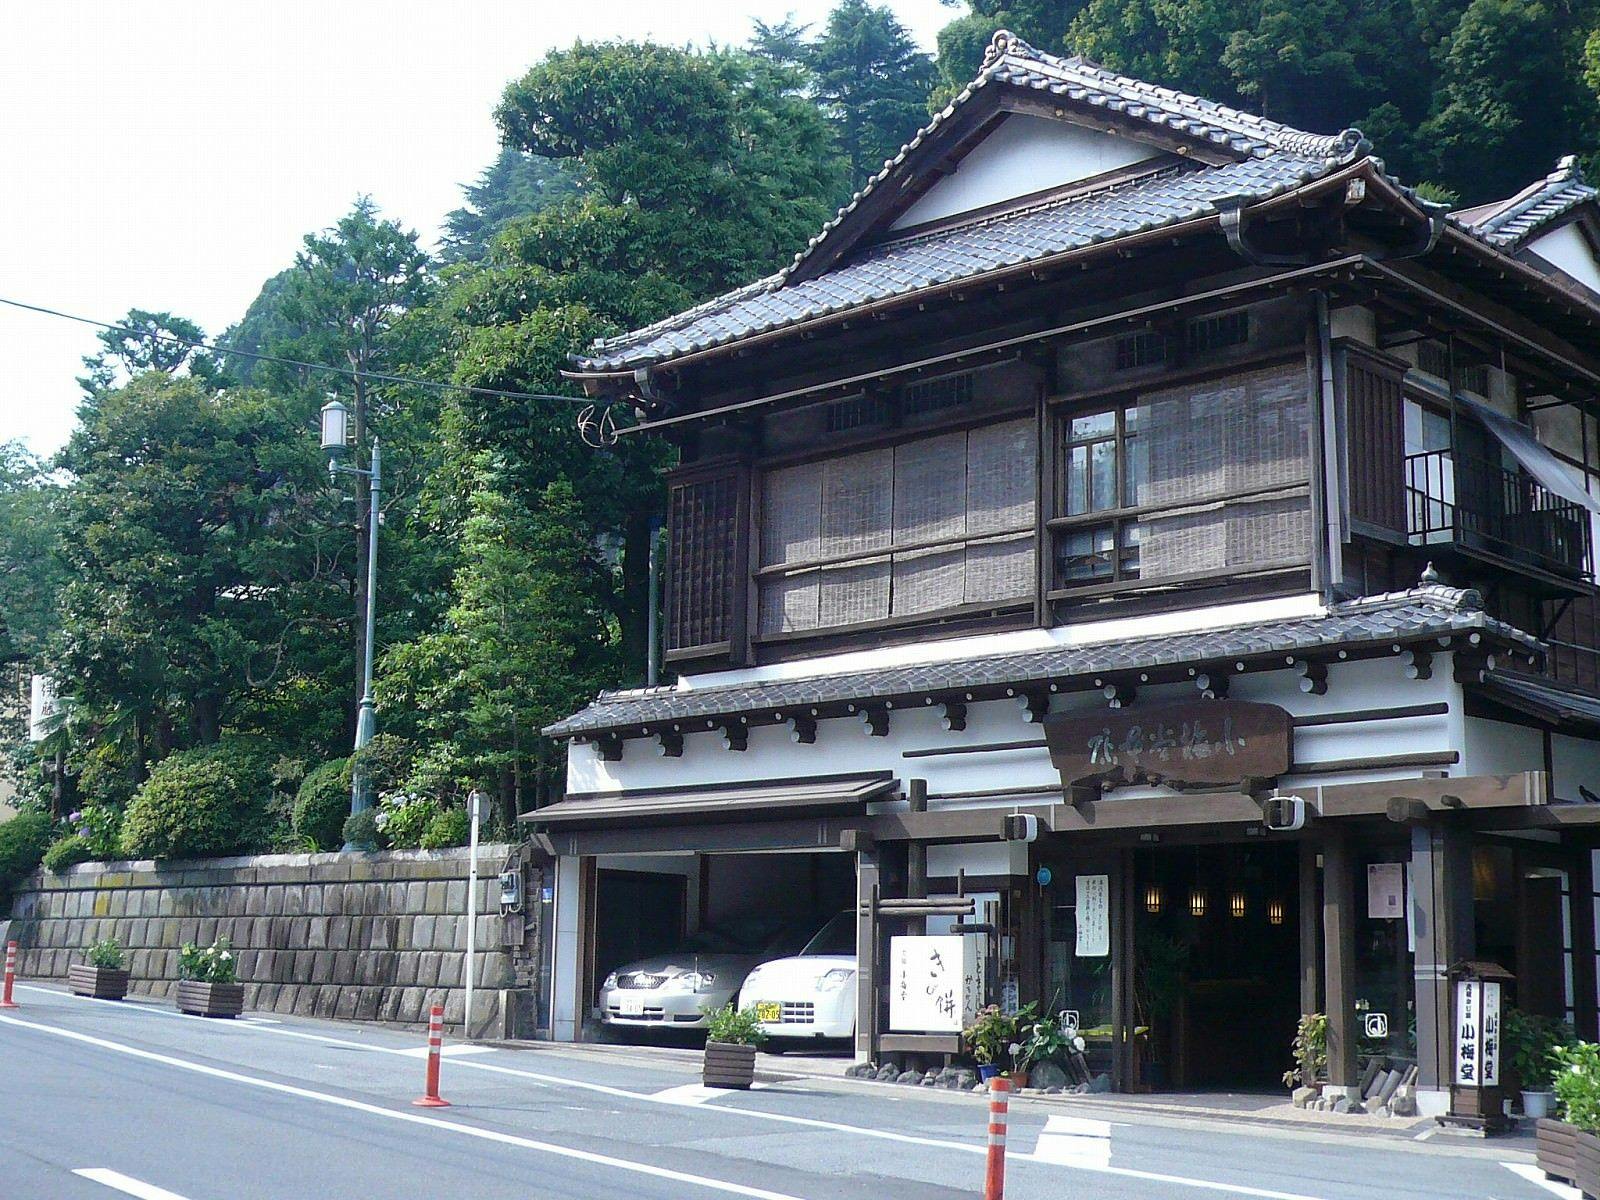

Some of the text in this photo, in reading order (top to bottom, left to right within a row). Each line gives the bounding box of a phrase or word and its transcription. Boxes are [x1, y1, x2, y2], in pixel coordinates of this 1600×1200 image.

[1461, 1023, 1475, 1080] 小梅堂
[1484, 1015, 1494, 1079] 小梅堂
